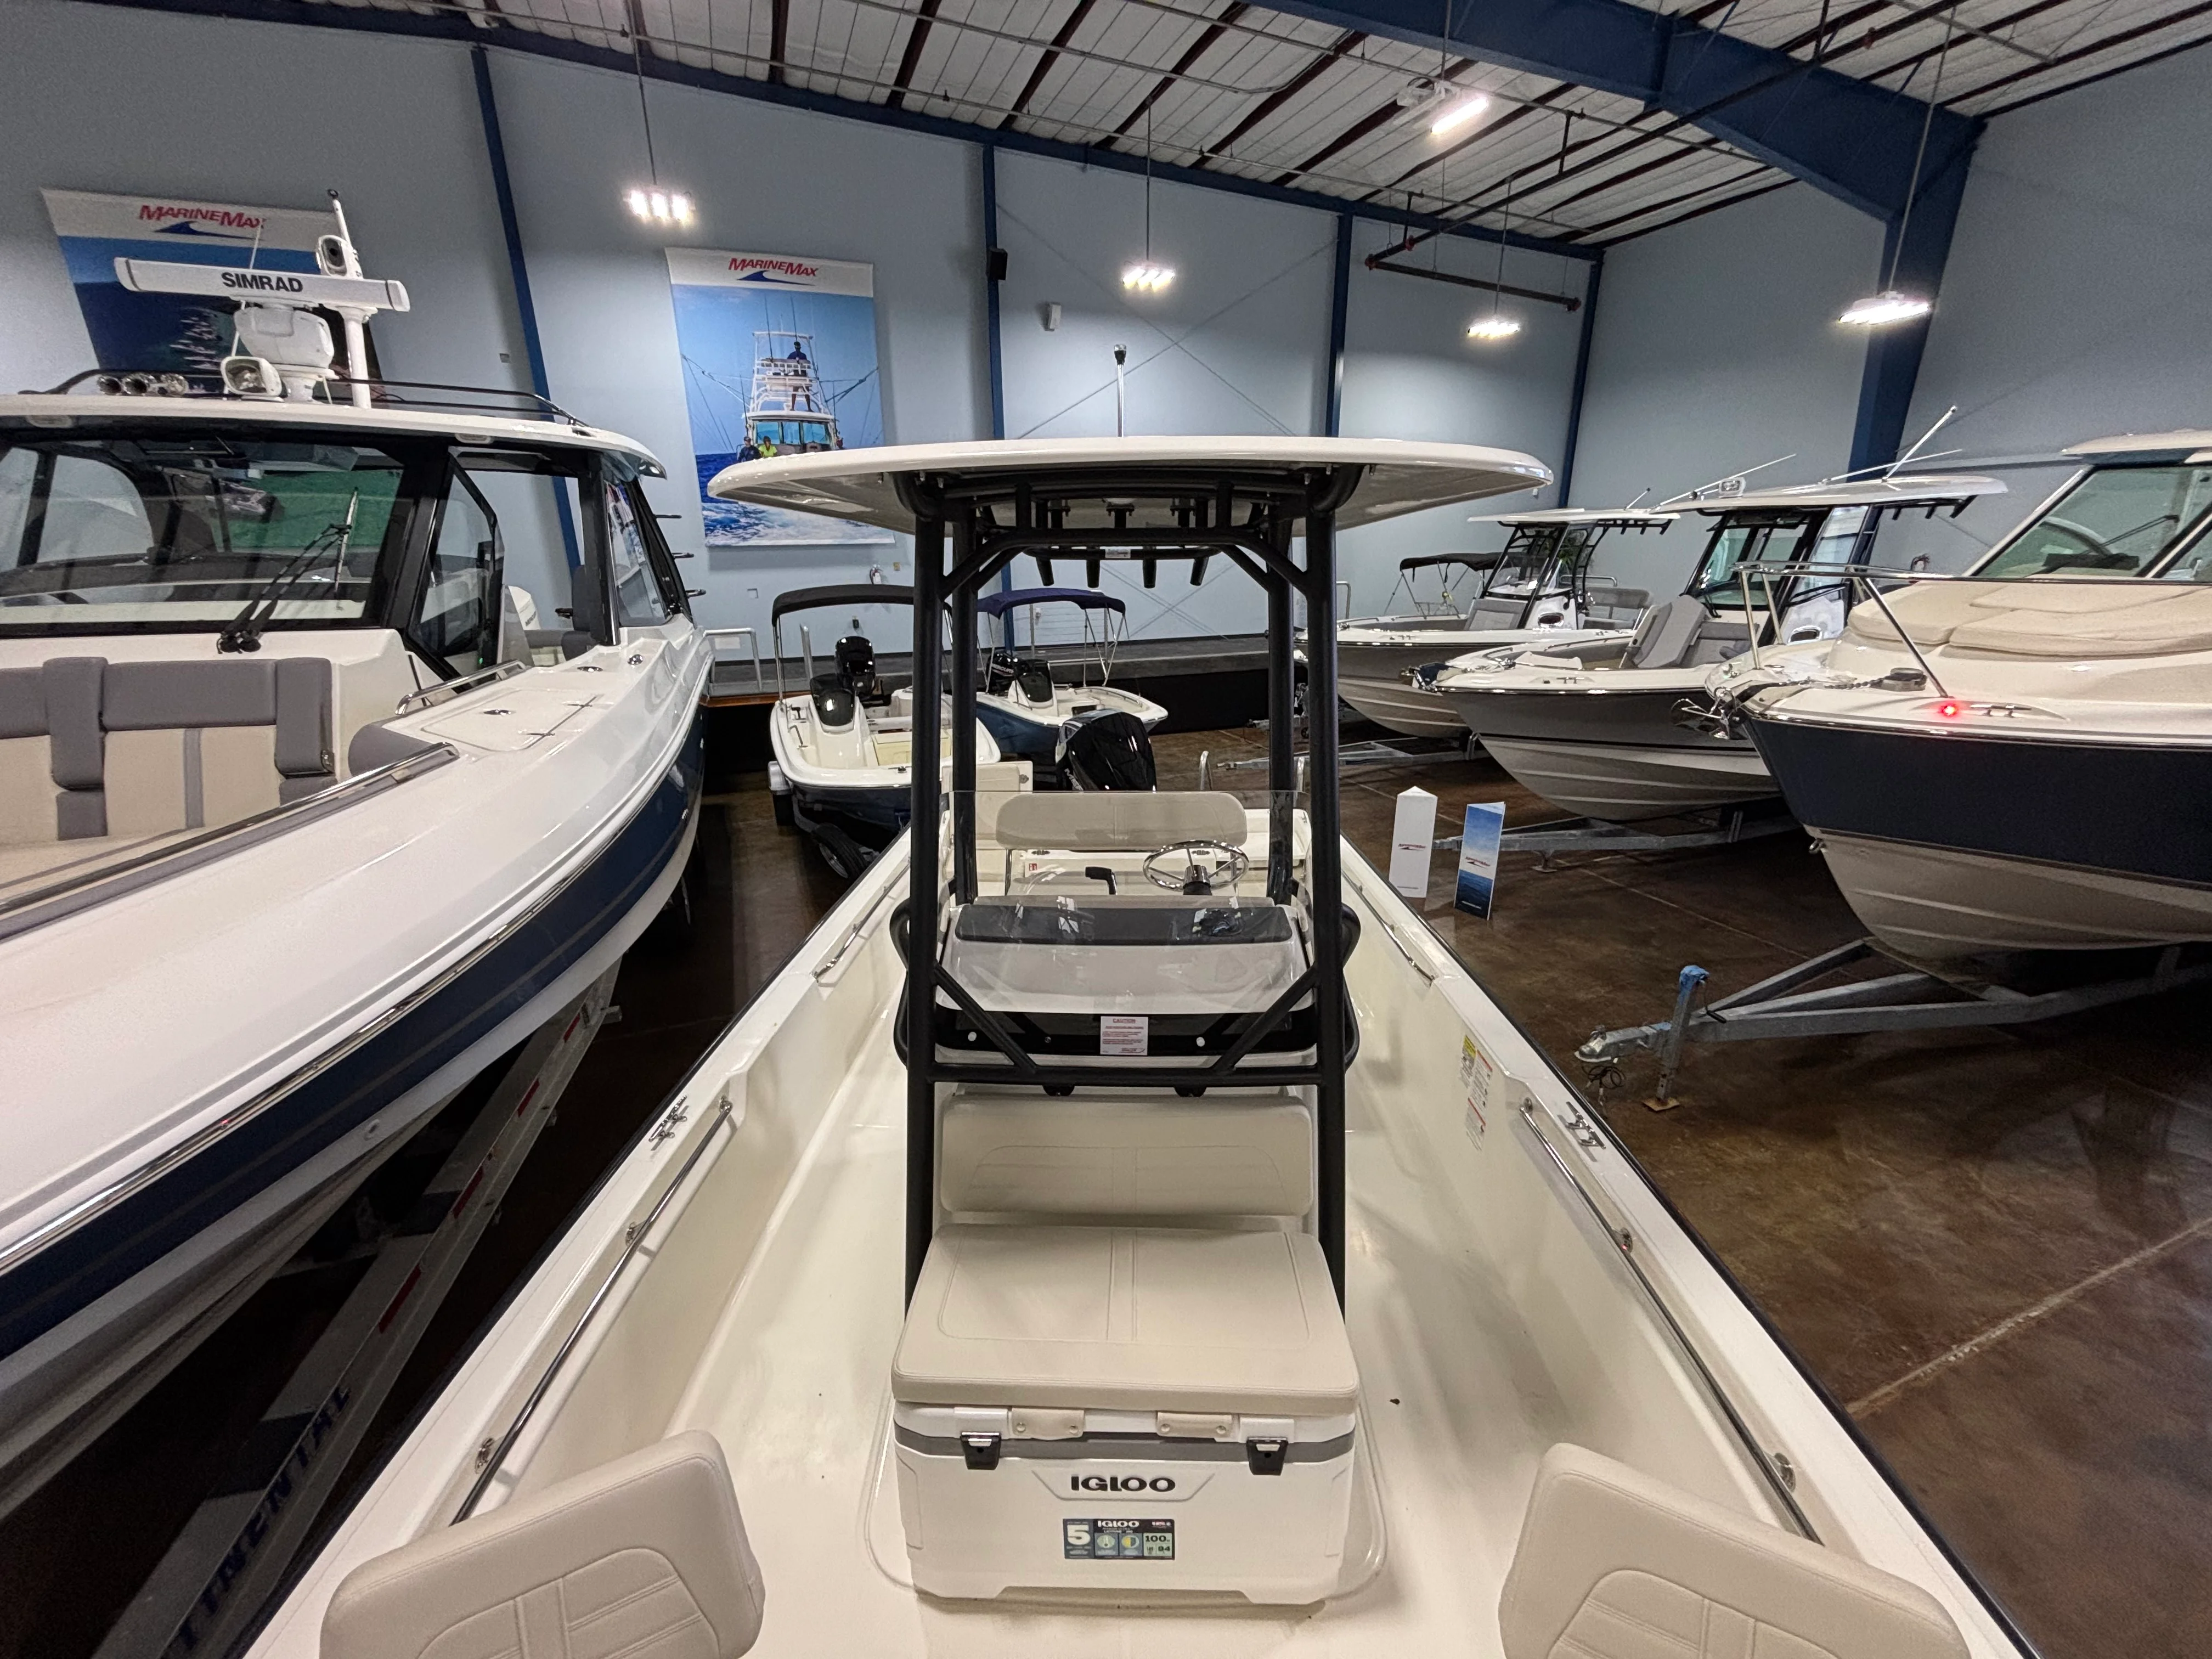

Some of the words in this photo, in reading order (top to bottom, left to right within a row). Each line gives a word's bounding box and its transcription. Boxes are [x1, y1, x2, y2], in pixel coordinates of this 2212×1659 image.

[729, 258, 818, 276] MARINEMAX
[221, 272, 303, 292] SIMRAD
[1071, 1476, 1176, 1492] IGLOO
[1066, 1524, 1091, 1545] 5
